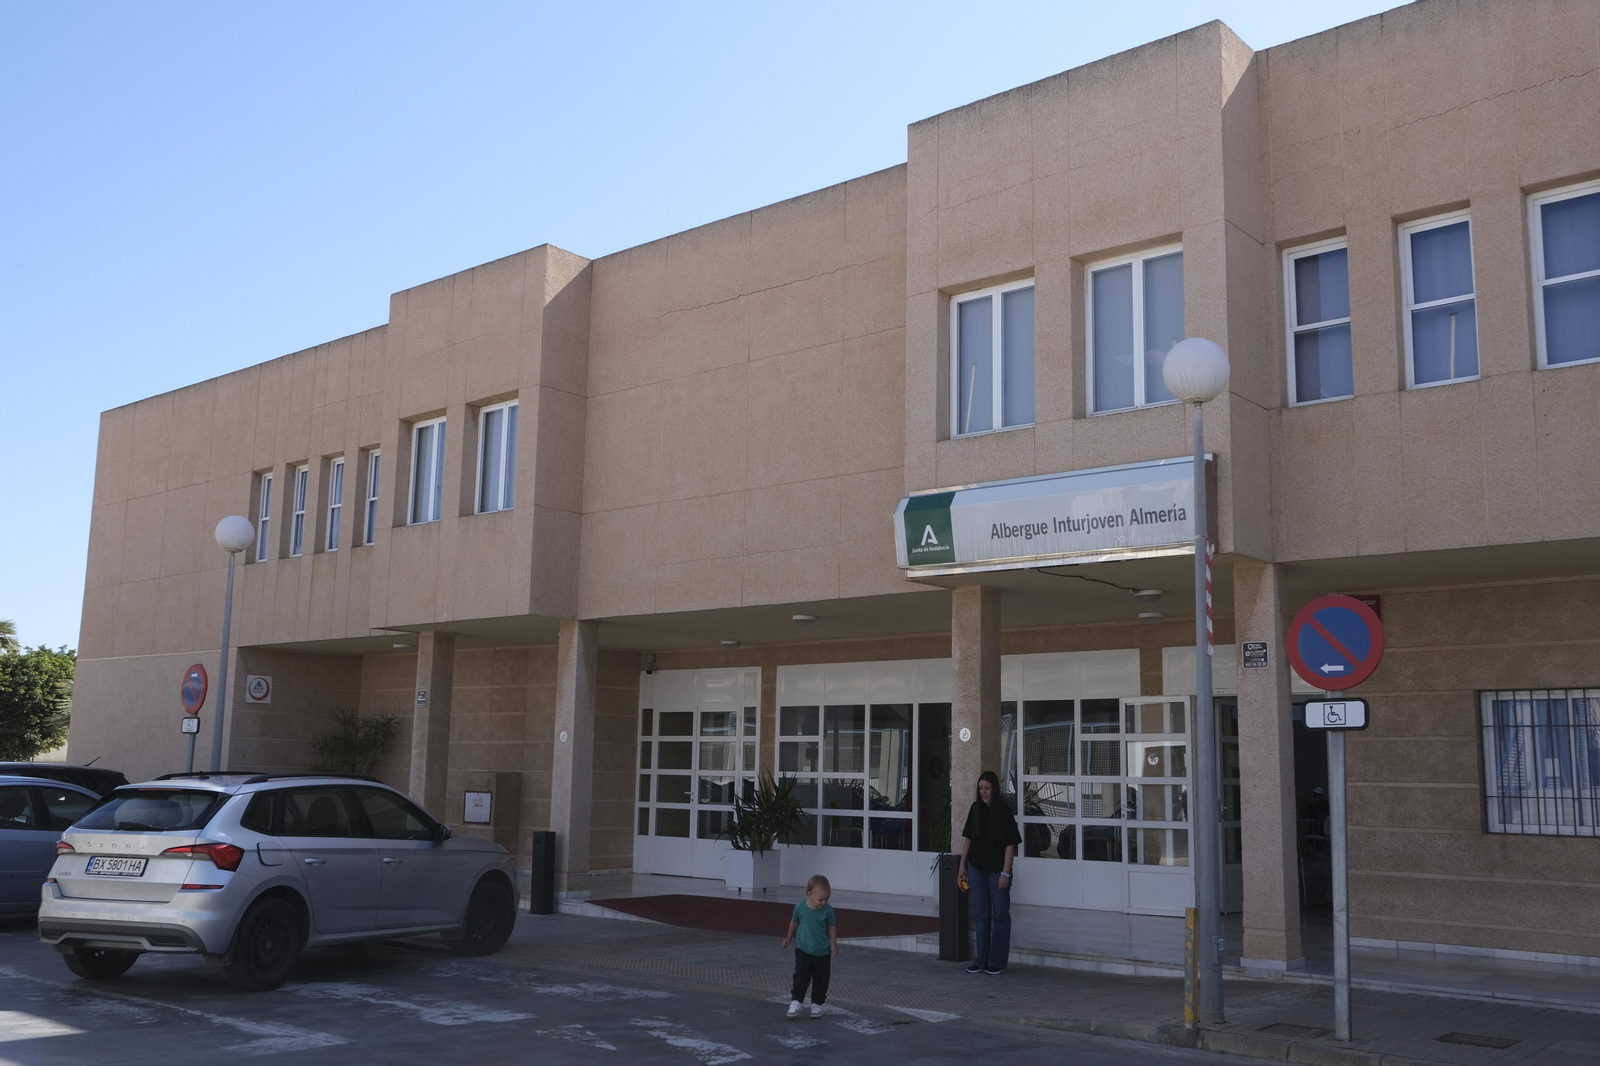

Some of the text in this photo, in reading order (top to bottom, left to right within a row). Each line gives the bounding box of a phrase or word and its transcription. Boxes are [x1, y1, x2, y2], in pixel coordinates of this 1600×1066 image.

[991, 503, 1187, 540] Albergue Inturjoven Almería
[93, 859, 141, 872] BX 5801 HA
